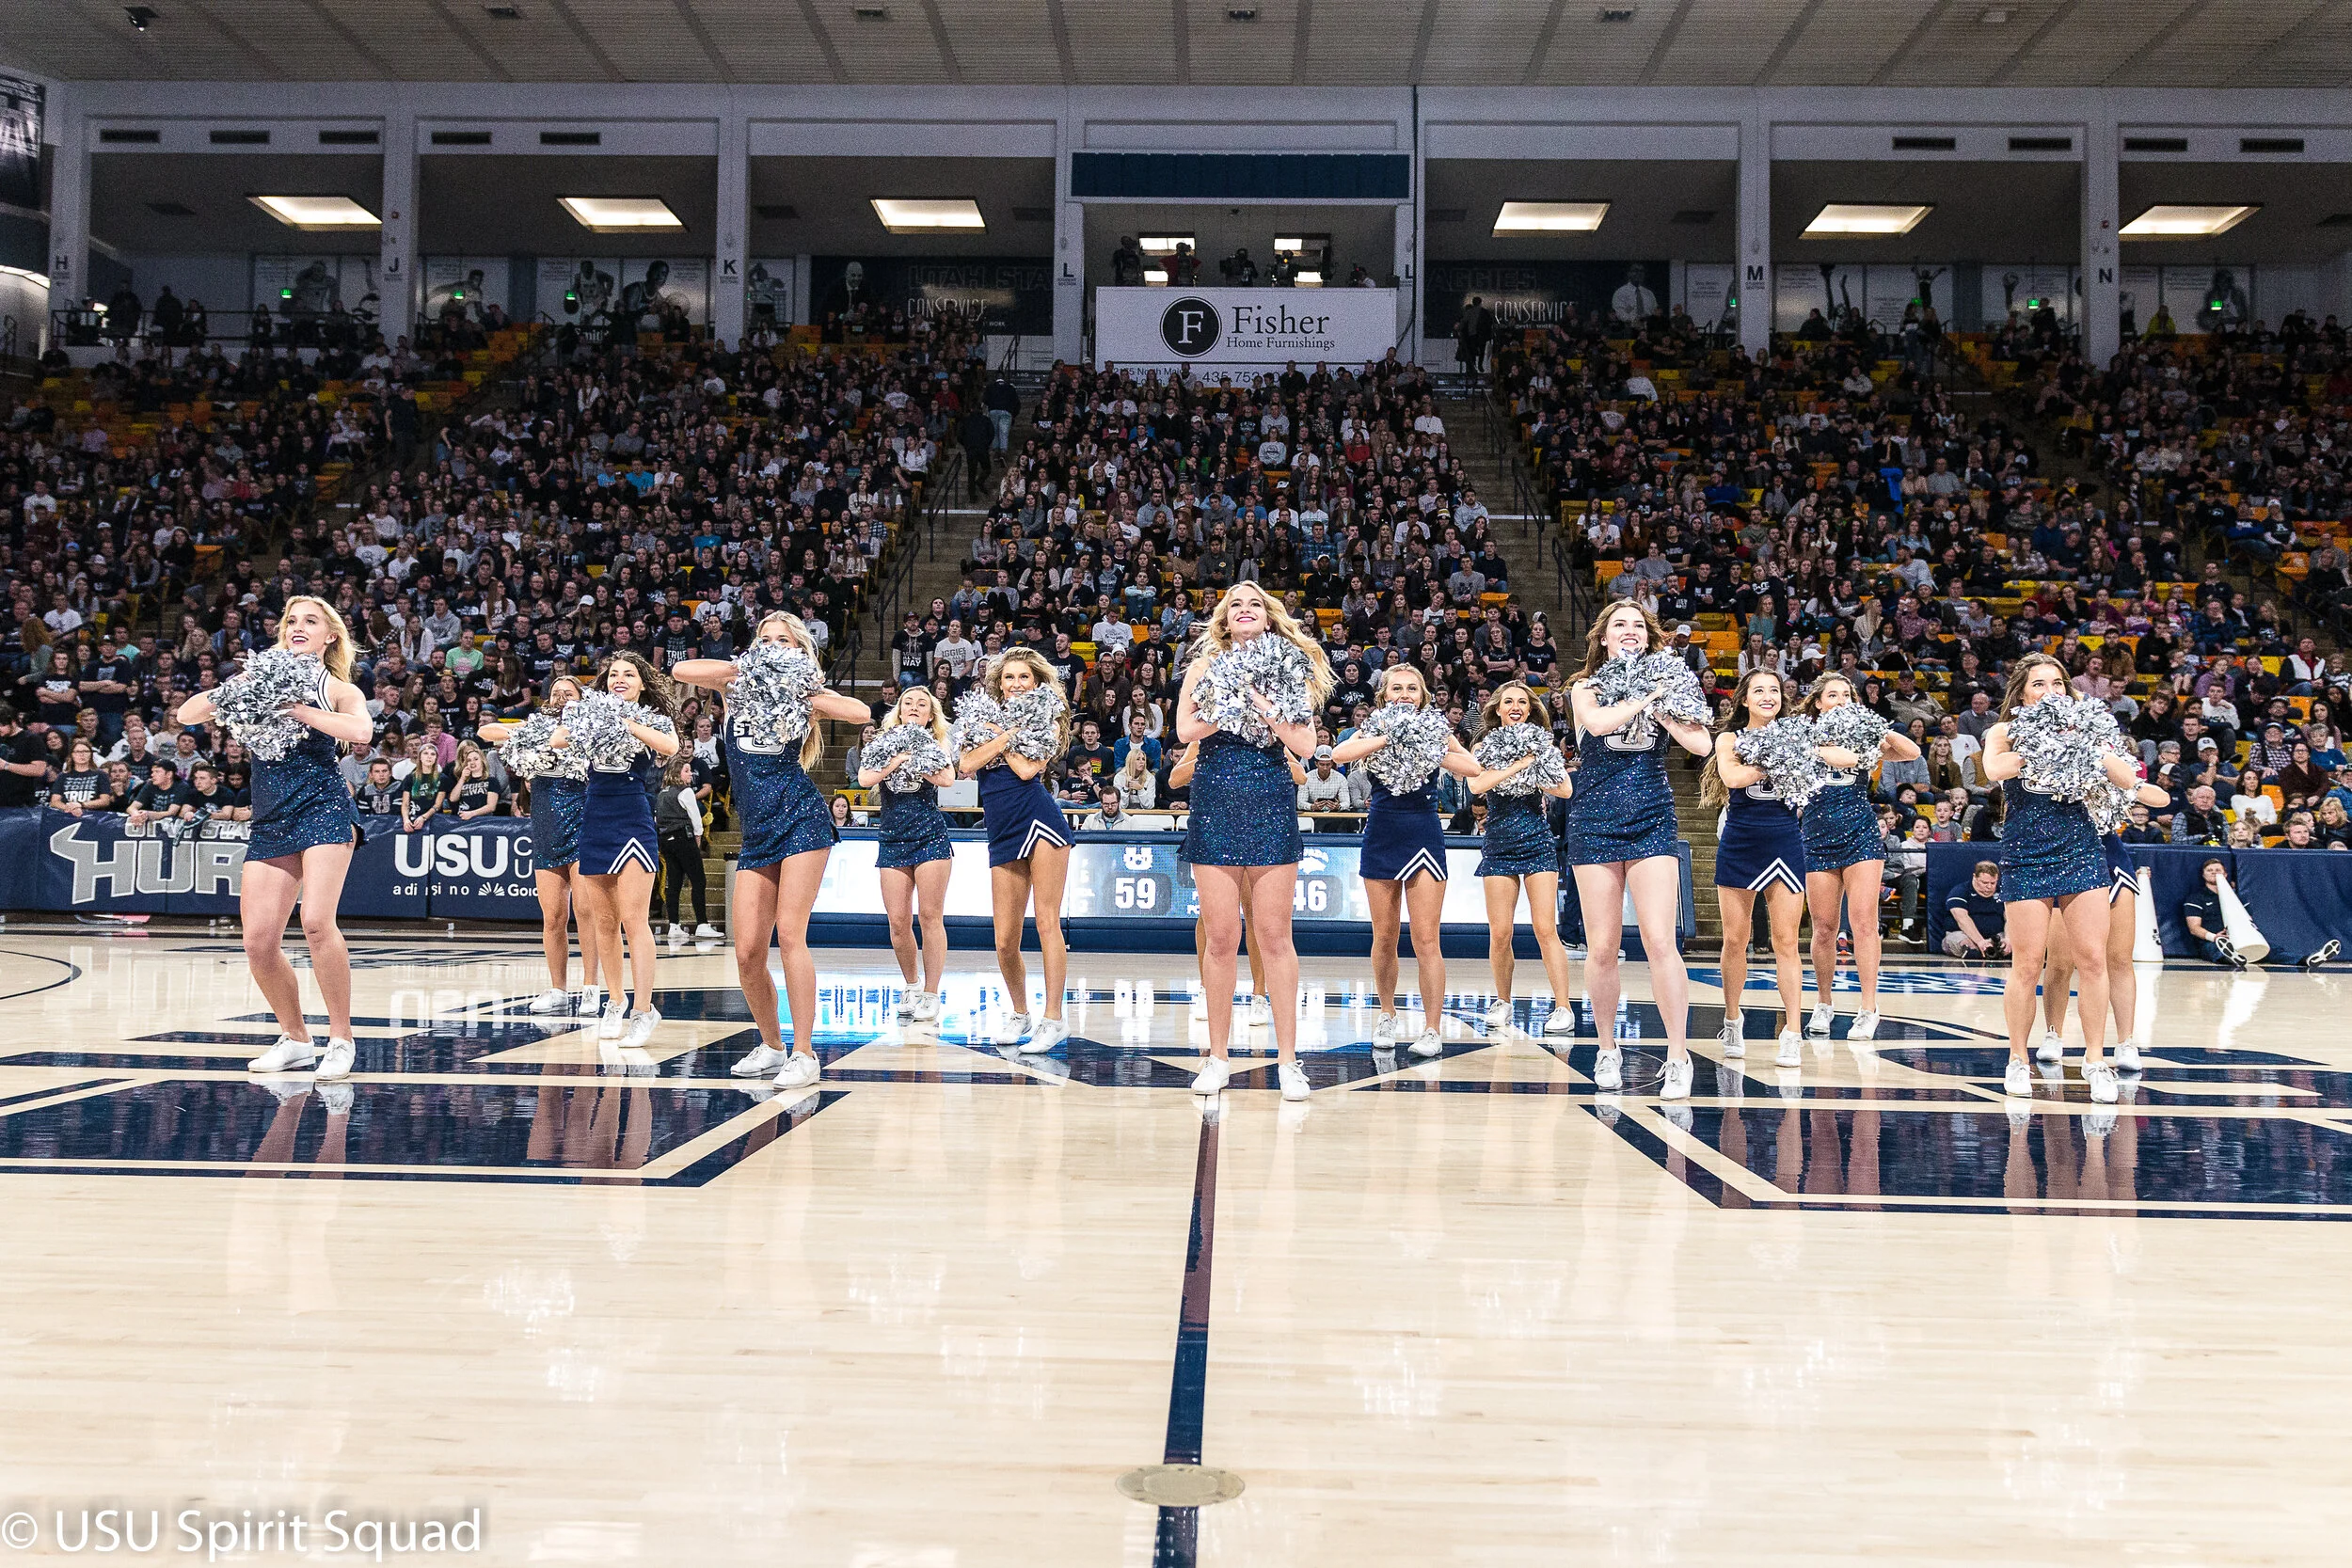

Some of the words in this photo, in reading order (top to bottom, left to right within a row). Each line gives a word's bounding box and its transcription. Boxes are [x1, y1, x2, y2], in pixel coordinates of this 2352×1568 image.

[56, 255, 68, 270] H
[389, 257, 399, 273] J
[723, 259, 737, 275] K
[1063, 262, 1074, 277] L
[995, 266, 1054, 291] STA
[1406, 264, 1414, 279] L
[1747, 265, 1763, 280] M
[2099, 268, 2112, 283] N
[1232, 305, 1330, 334] Fisher
[1494, 299, 1575, 325] CONSERVIC
[1177, 310, 1204, 343] F
[1227, 337, 1263, 348] Home
[1266, 337, 1335, 351] Furnishings
[1165, 368, 1183, 376] Mai
[50, 821, 248, 905] HUR
[394, 833, 509, 879] USU
[1115, 877, 1157, 910] 59
[1293, 879, 1327, 911] 46
